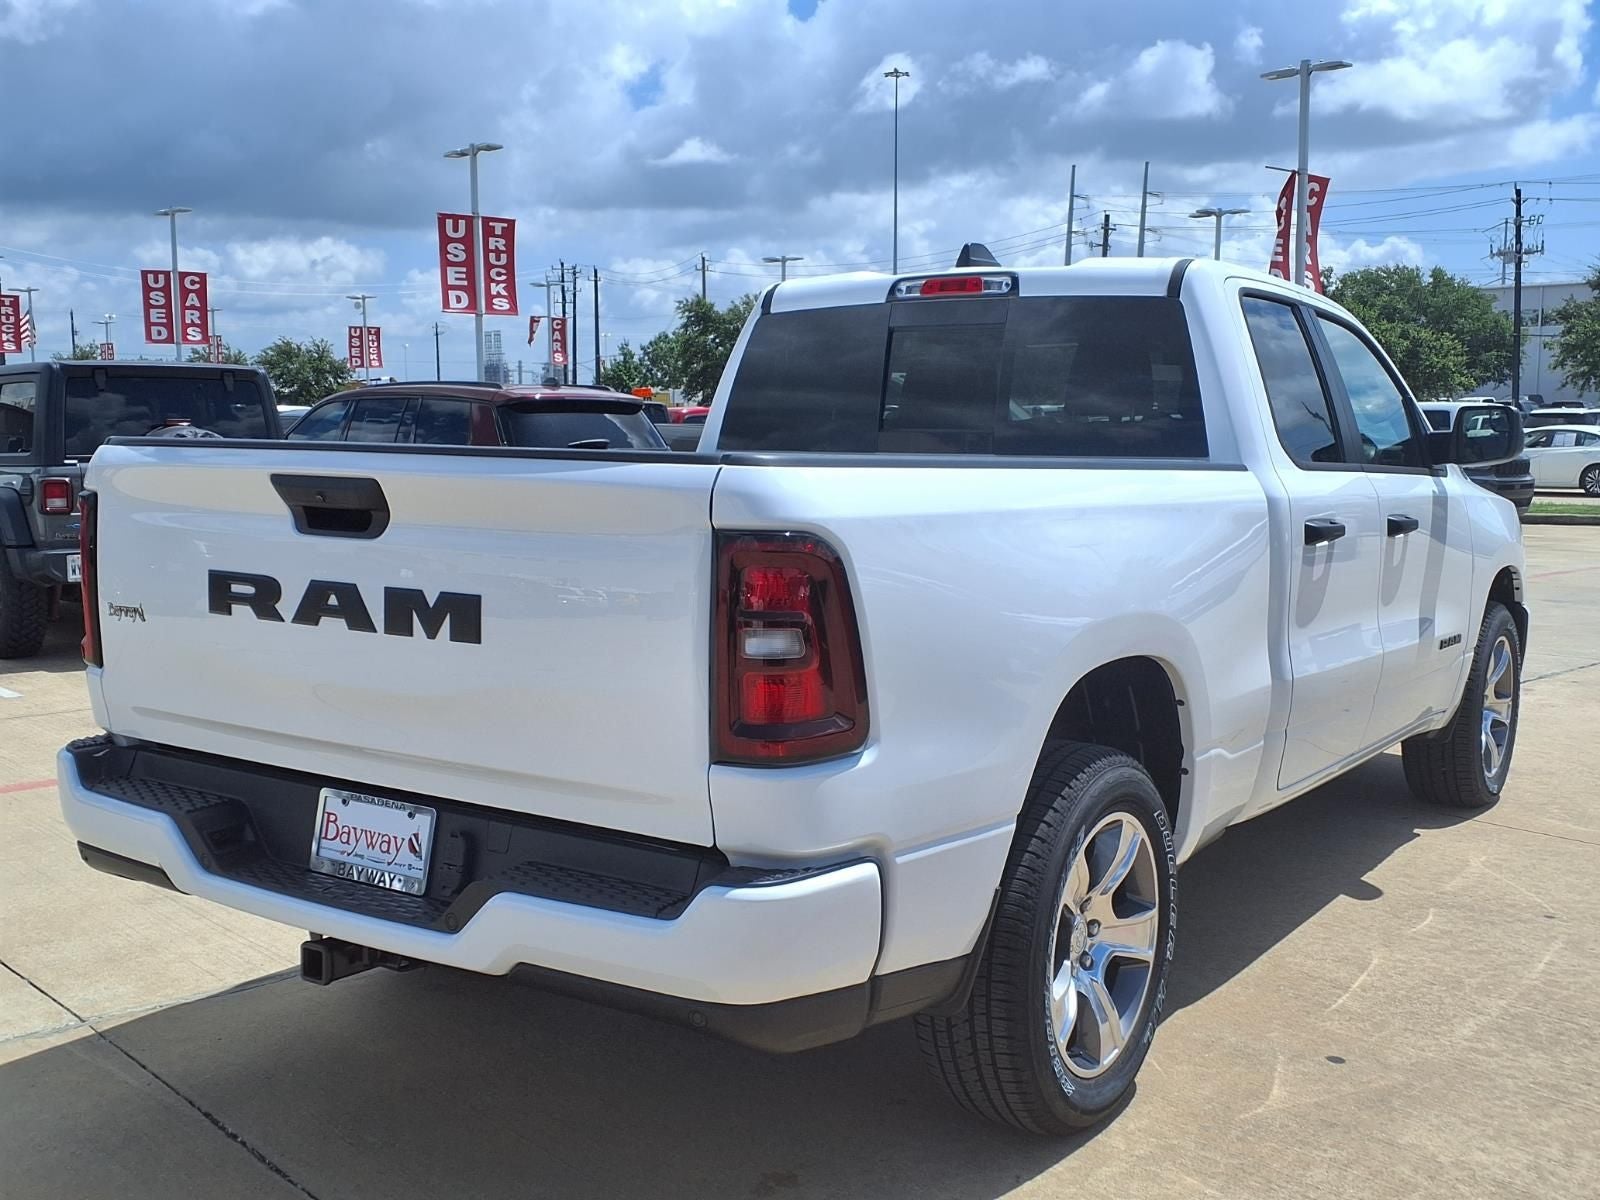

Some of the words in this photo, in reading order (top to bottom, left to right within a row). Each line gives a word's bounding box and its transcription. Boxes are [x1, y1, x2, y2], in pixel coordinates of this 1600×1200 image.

[445, 219, 469, 309] USED
[488, 222, 510, 310] TRUCKS
[0, 297, 16, 350] TRUCKS
[147, 274, 169, 340] USED
[183, 275, 203, 341] CARS
[350, 327, 361, 366] USED
[368, 328, 379, 366] TRUCKS
[552, 319, 564, 362] CARS
[208, 568, 482, 645] RAM
[349, 793, 407, 811] PASADENA
[321, 811, 405, 866] Bayway
[337, 862, 397, 889] BAYWAY
